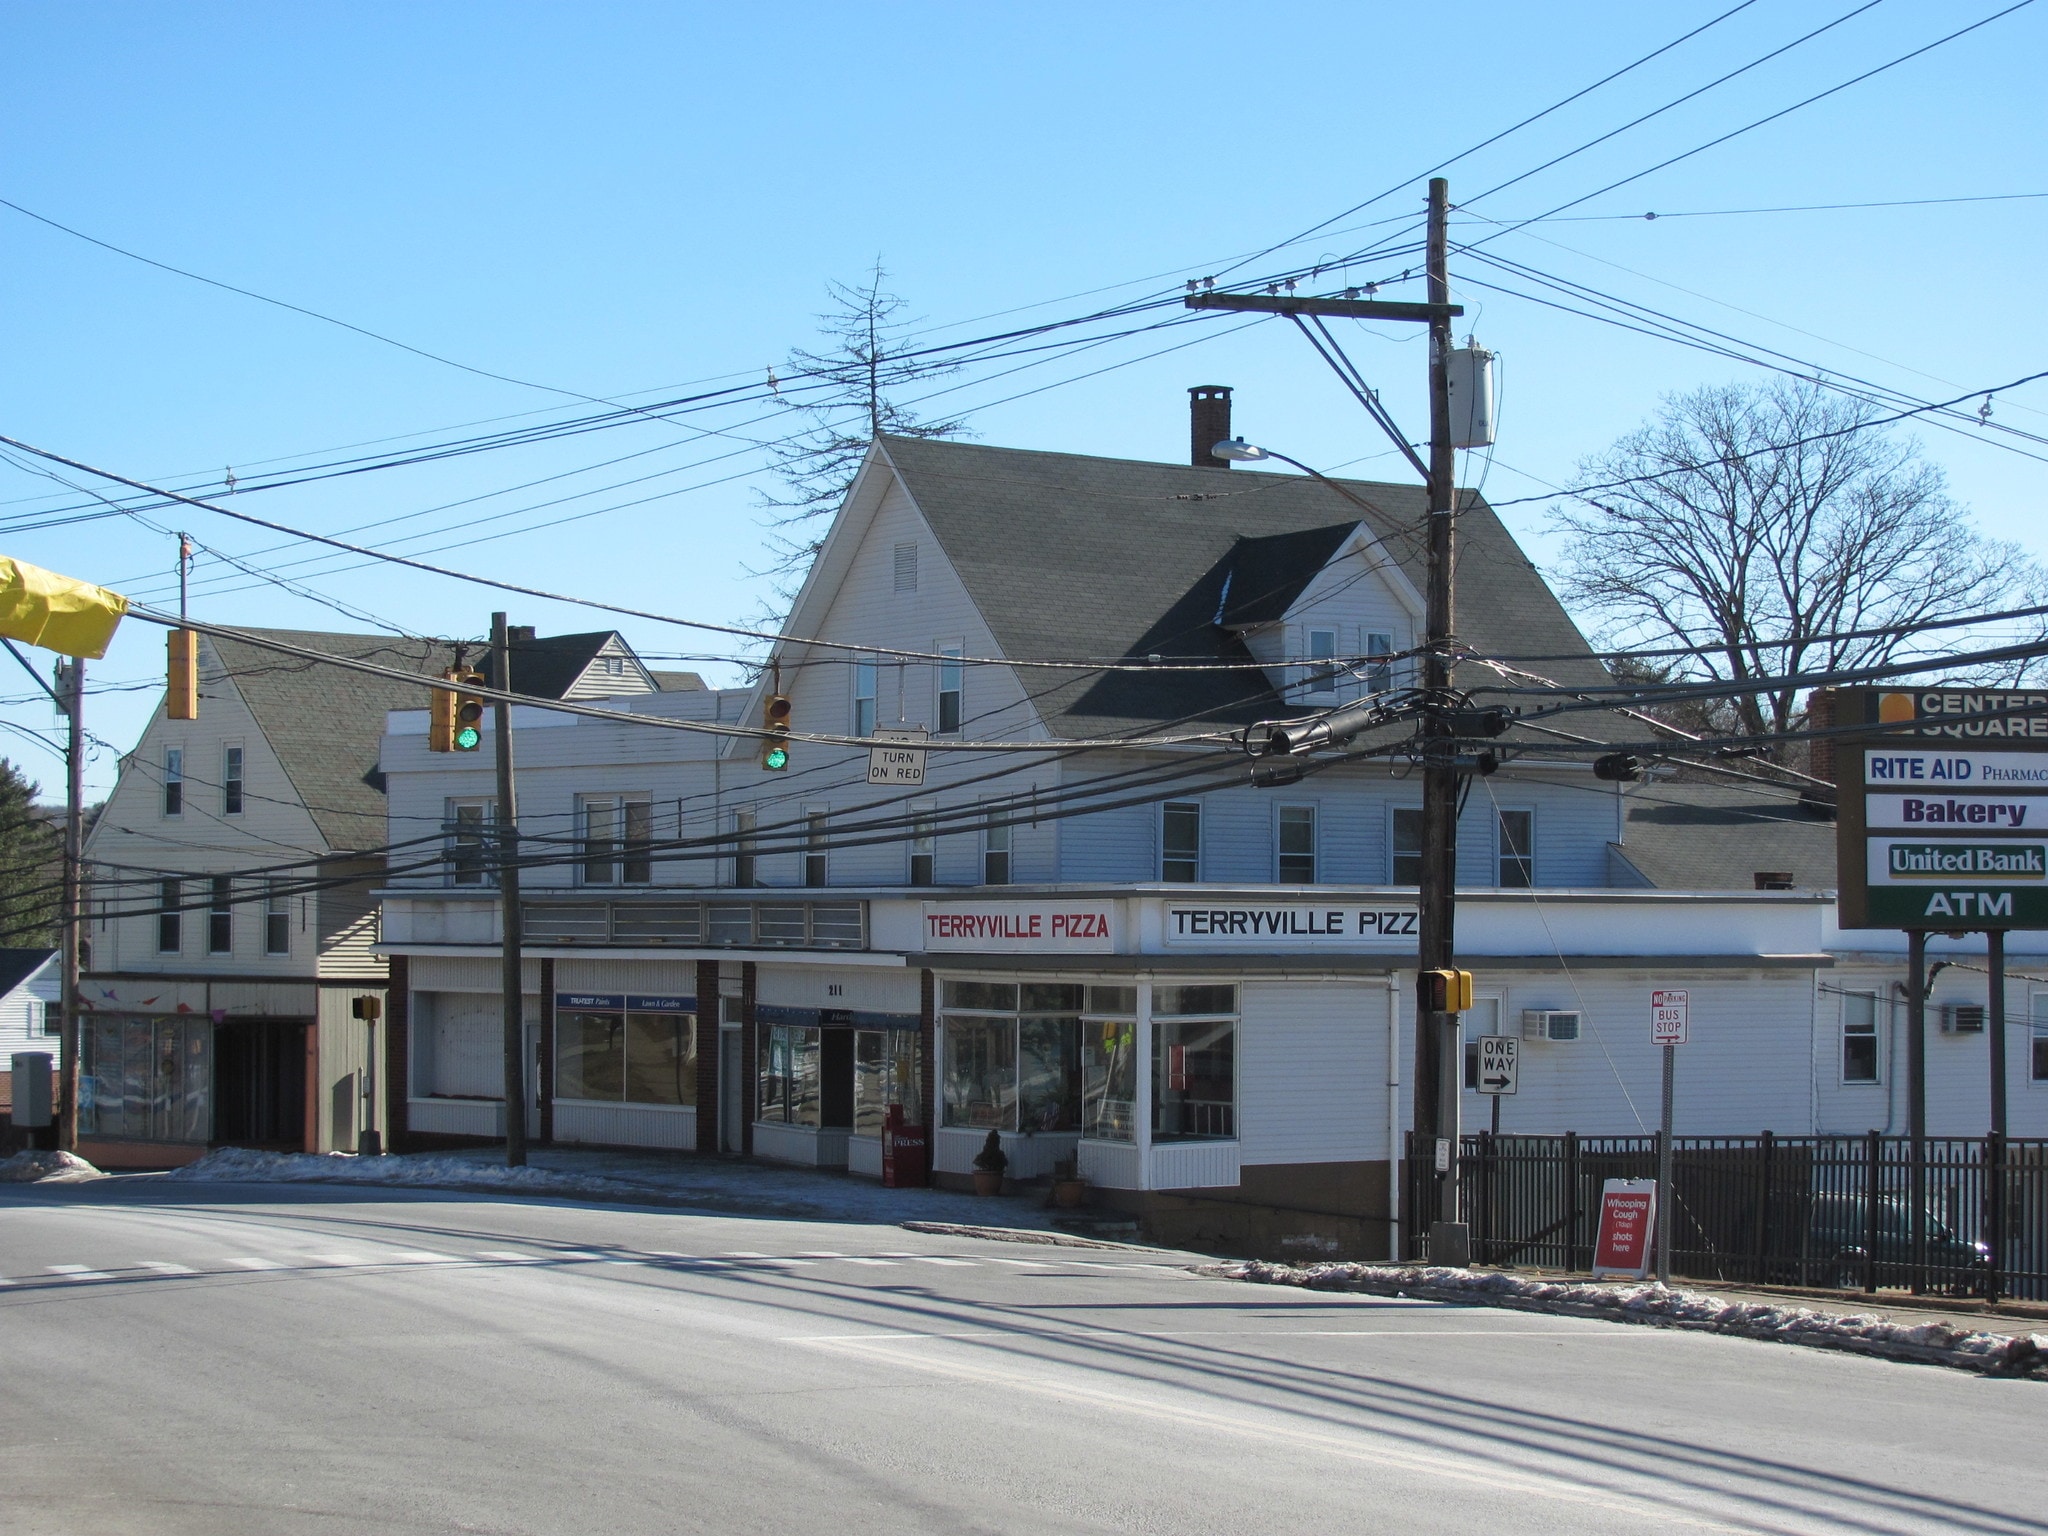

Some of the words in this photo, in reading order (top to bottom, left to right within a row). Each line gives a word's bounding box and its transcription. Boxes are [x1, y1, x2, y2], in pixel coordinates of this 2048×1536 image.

[882, 752, 914, 763] TURN
[871, 767, 888, 778] ON
[896, 768, 921, 778] RED
[1871, 757, 1924, 779] RITE
[1930, 759, 1971, 779] AID
[1903, 799, 2027, 827] Bakery
[1892, 847, 1974, 871] United
[1976, 849, 2043, 871] Bank
[1924, 892, 2012, 916] ATM
[927, 914, 1041, 938] TERRYVILLE
[1052, 914, 1109, 938] PIZZA
[1171, 910, 1344, 935] TERRYVILLE
[1358, 911, 1420, 935] PIZZ
[829, 984, 842, 996] 211
[1653, 993, 1663, 1005] NO
[1658, 1010, 1679, 1020] BUS
[1656, 1022, 1681, 1033] STOP
[1484, 1040, 1514, 1055] ONE
[1484, 1057, 1515, 1071] WAY
[894, 1138, 925, 1147] PRESS
[1607, 1199, 1646, 1209] Whooping
[1612, 1209, 1638, 1220] Cough
[1612, 1231, 1633, 1241] shots
[1612, 1242, 1630, 1252] here
